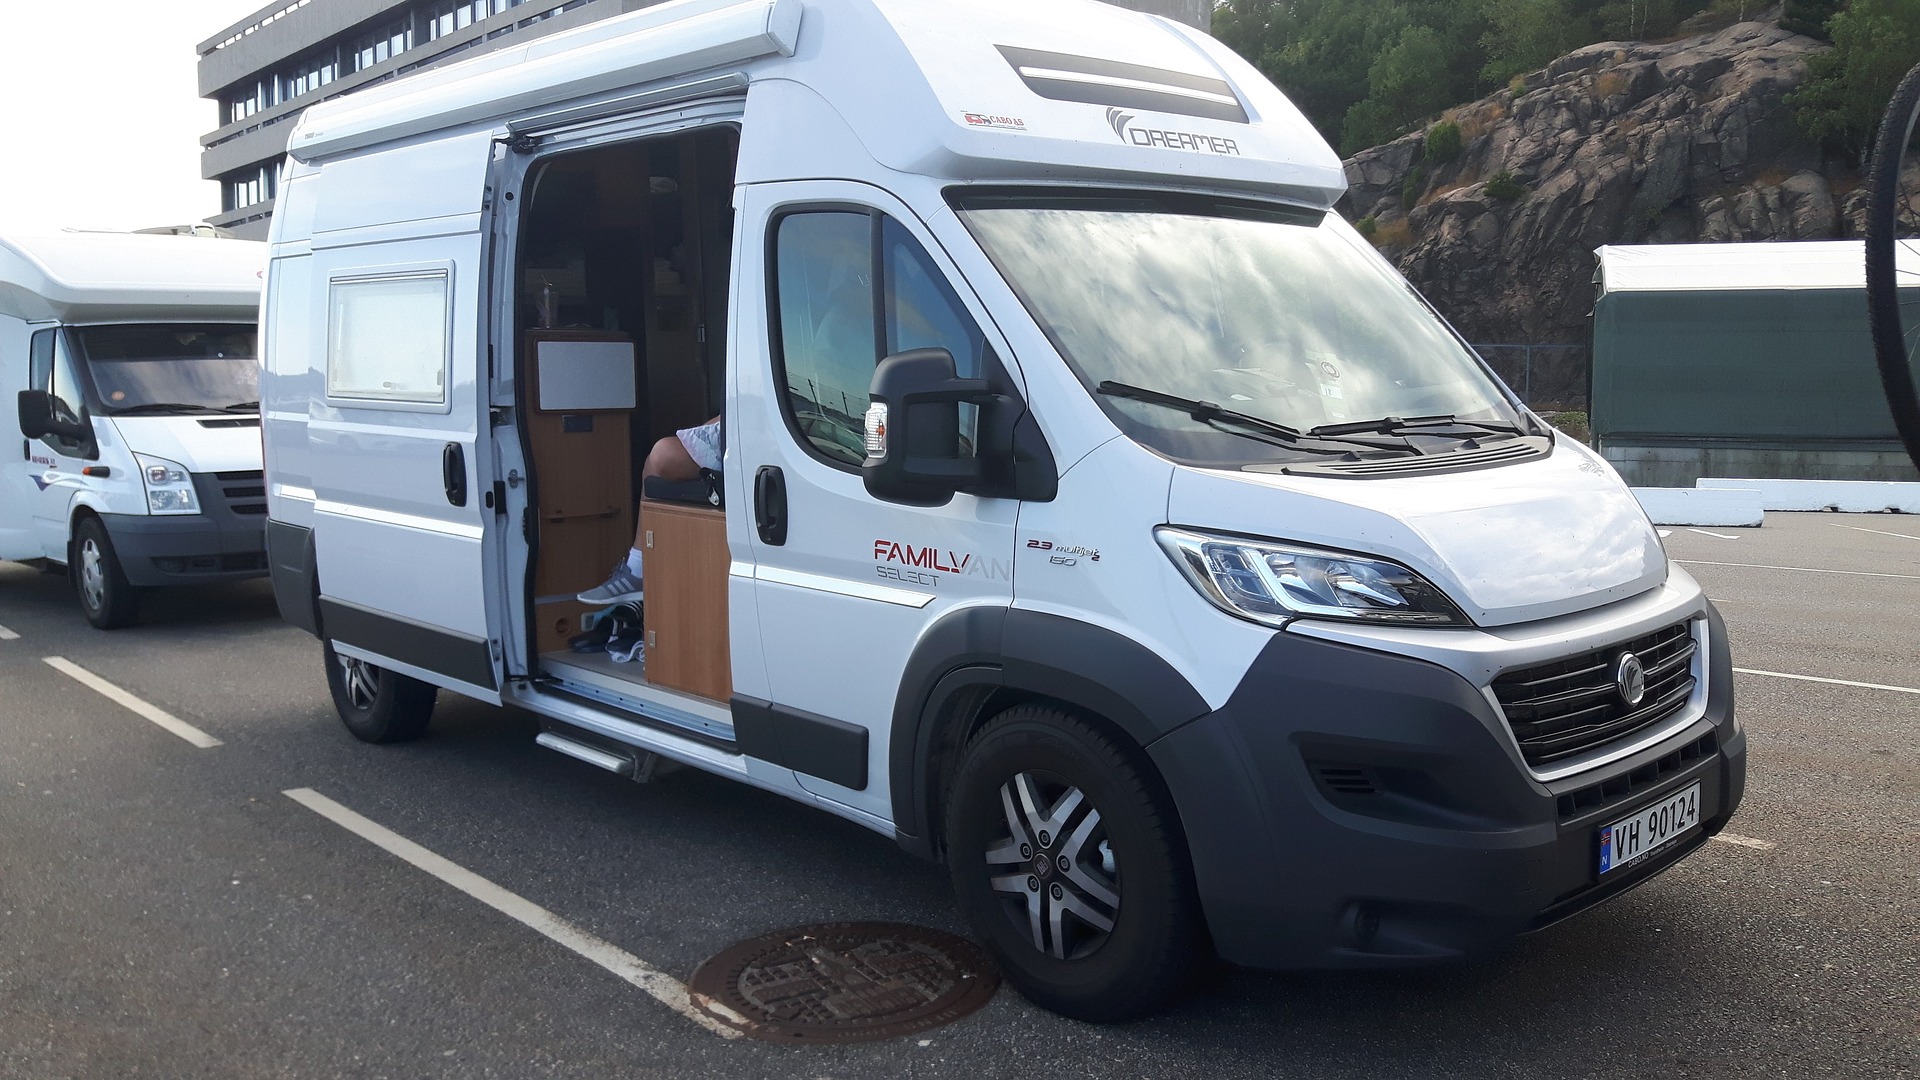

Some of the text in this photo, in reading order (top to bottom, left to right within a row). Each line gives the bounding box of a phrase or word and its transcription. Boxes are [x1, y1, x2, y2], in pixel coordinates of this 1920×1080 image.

[1129, 127, 1240, 155] DREAMER
[876, 565, 940, 587] SELECT
[1615, 791, 1695, 860] VH 90124
[1601, 854, 1608, 866] N
